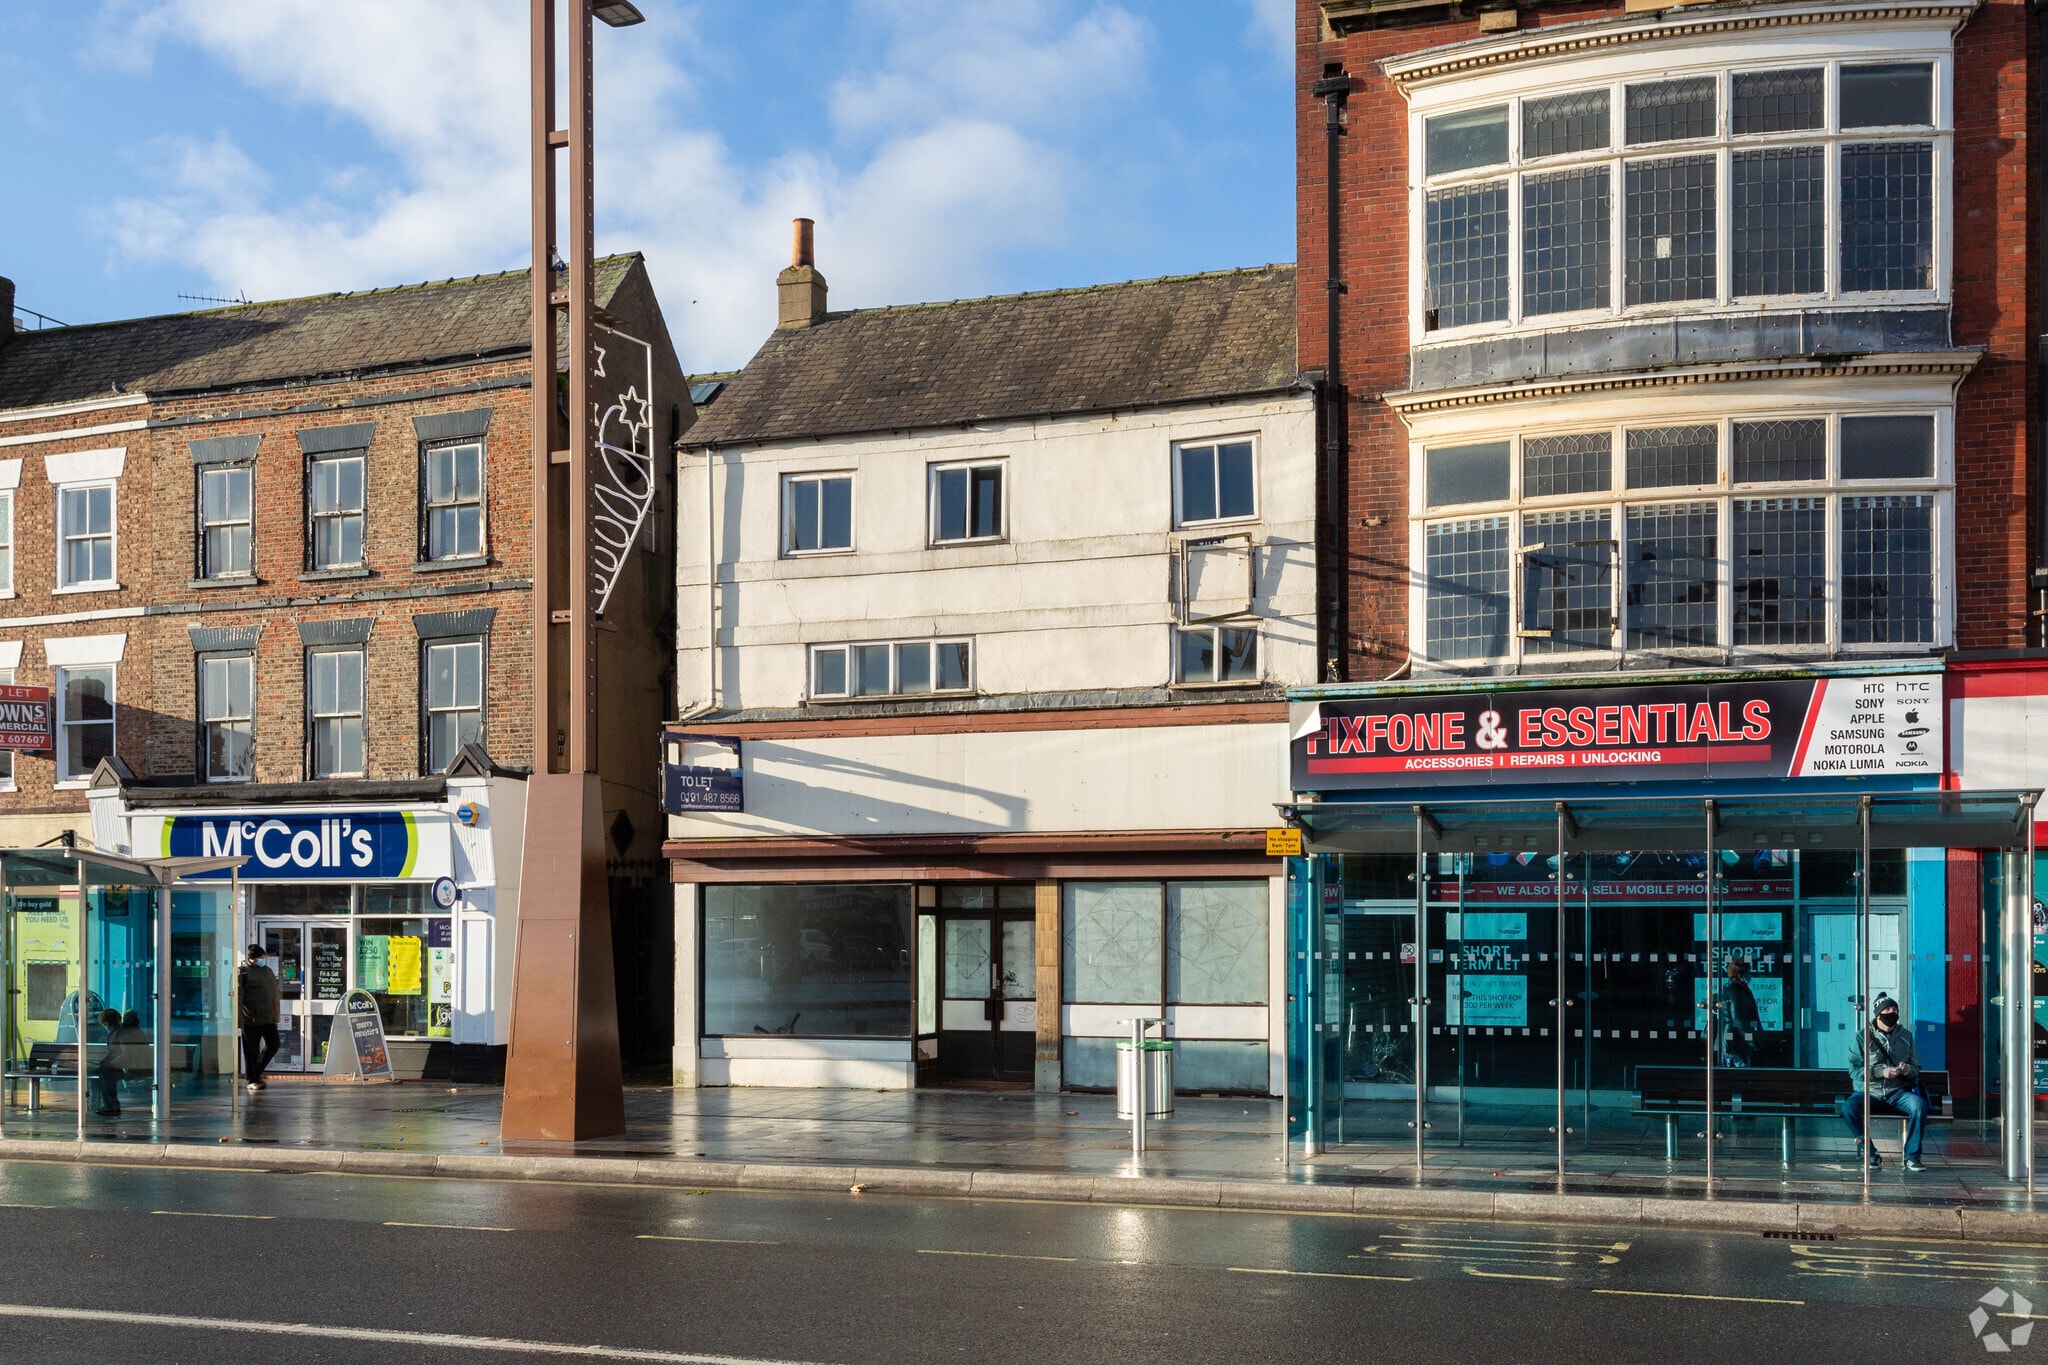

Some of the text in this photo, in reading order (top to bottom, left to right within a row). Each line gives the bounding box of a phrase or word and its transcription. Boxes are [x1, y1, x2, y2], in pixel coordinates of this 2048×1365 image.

[8, 688, 32, 698] LET
[1863, 683, 1885, 694] HTC
[1855, 698, 1885, 709] SONY
[1896, 698, 1930, 706] SONY
[1850, 713, 1885, 725] APPLE
[1307, 700, 1772, 755] FIXFONE & ESSENTIALS
[8, 735, 46, 744] 607607
[1830, 728, 1885, 740] SAMSUNG
[1824, 743, 1885, 755] MOTOROLA
[1405, 756, 1494, 769] ACCESSORIES
[1510, 754, 1565, 767] REPAIRS
[1582, 751, 1662, 764] UNLOCKING
[1813, 759, 1885, 771] NOKIA LUMIA
[680, 776, 714, 788] TO LET
[680, 791, 740, 804] 0191 487 8566
[202, 818, 374, 869] McColl's
[1497, 886, 1516, 895] WE
[1518, 885, 1551, 896] ALSO
[1553, 885, 1578, 895] BUY
[1592, 885, 1623, 895] SELL
[1626, 884, 1674, 895] MOBILE
[27, 901, 38, 909] buy
[39, 901, 52, 909] gold
[319, 942, 340, 950] Opening
[1463, 945, 1510, 957] SHORT
[1711, 946, 1764, 959] SHORT
[1453, 959, 1520, 970] TERM LET
[1700, 960, 1775, 973] TER LET
[1752, 983, 1777, 991] TERMS
[1488, 994, 1508, 1002] SHOP
[1764, 997, 1778, 1005] FOR
